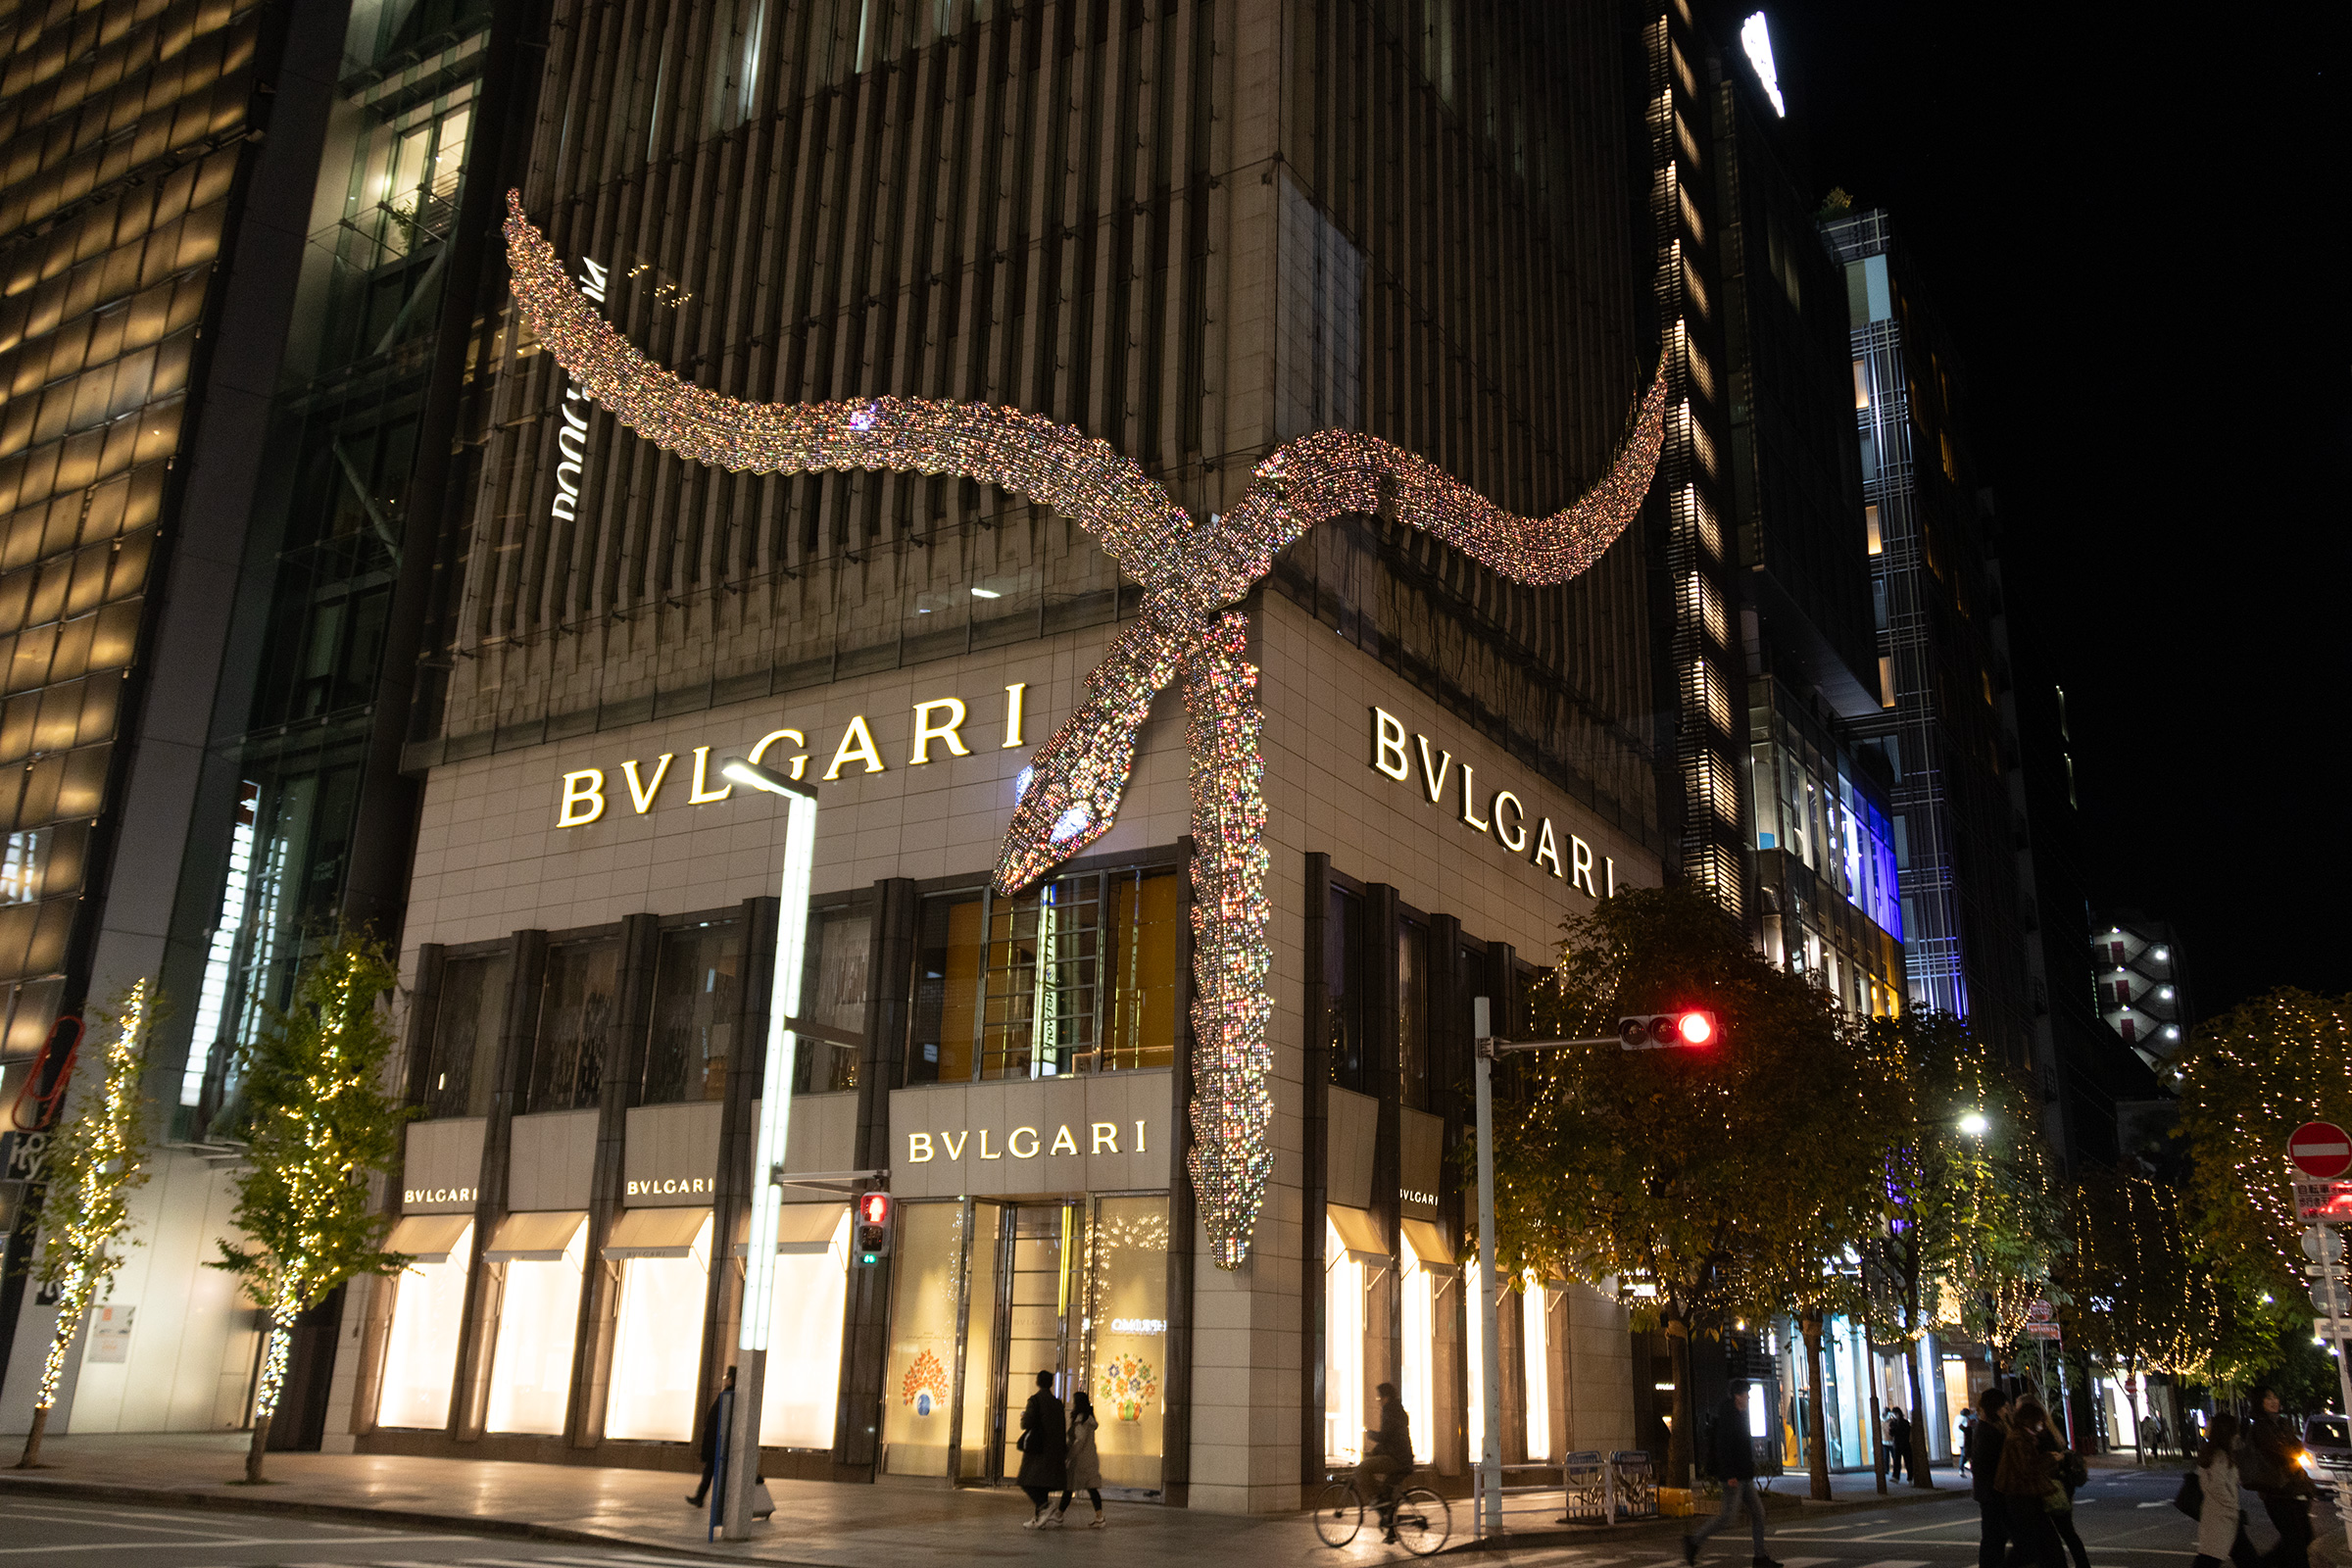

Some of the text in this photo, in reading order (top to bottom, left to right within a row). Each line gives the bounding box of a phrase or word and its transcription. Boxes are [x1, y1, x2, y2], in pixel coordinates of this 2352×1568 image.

[556, 683, 1027, 829] BVLGARI
[1372, 706, 1615, 899] BVLGARI
[908, 1120, 1147, 1163] BVLGARI
[404, 1188, 477, 1203] BVLGARI
[627, 1178, 713, 1195] BVLGARI
